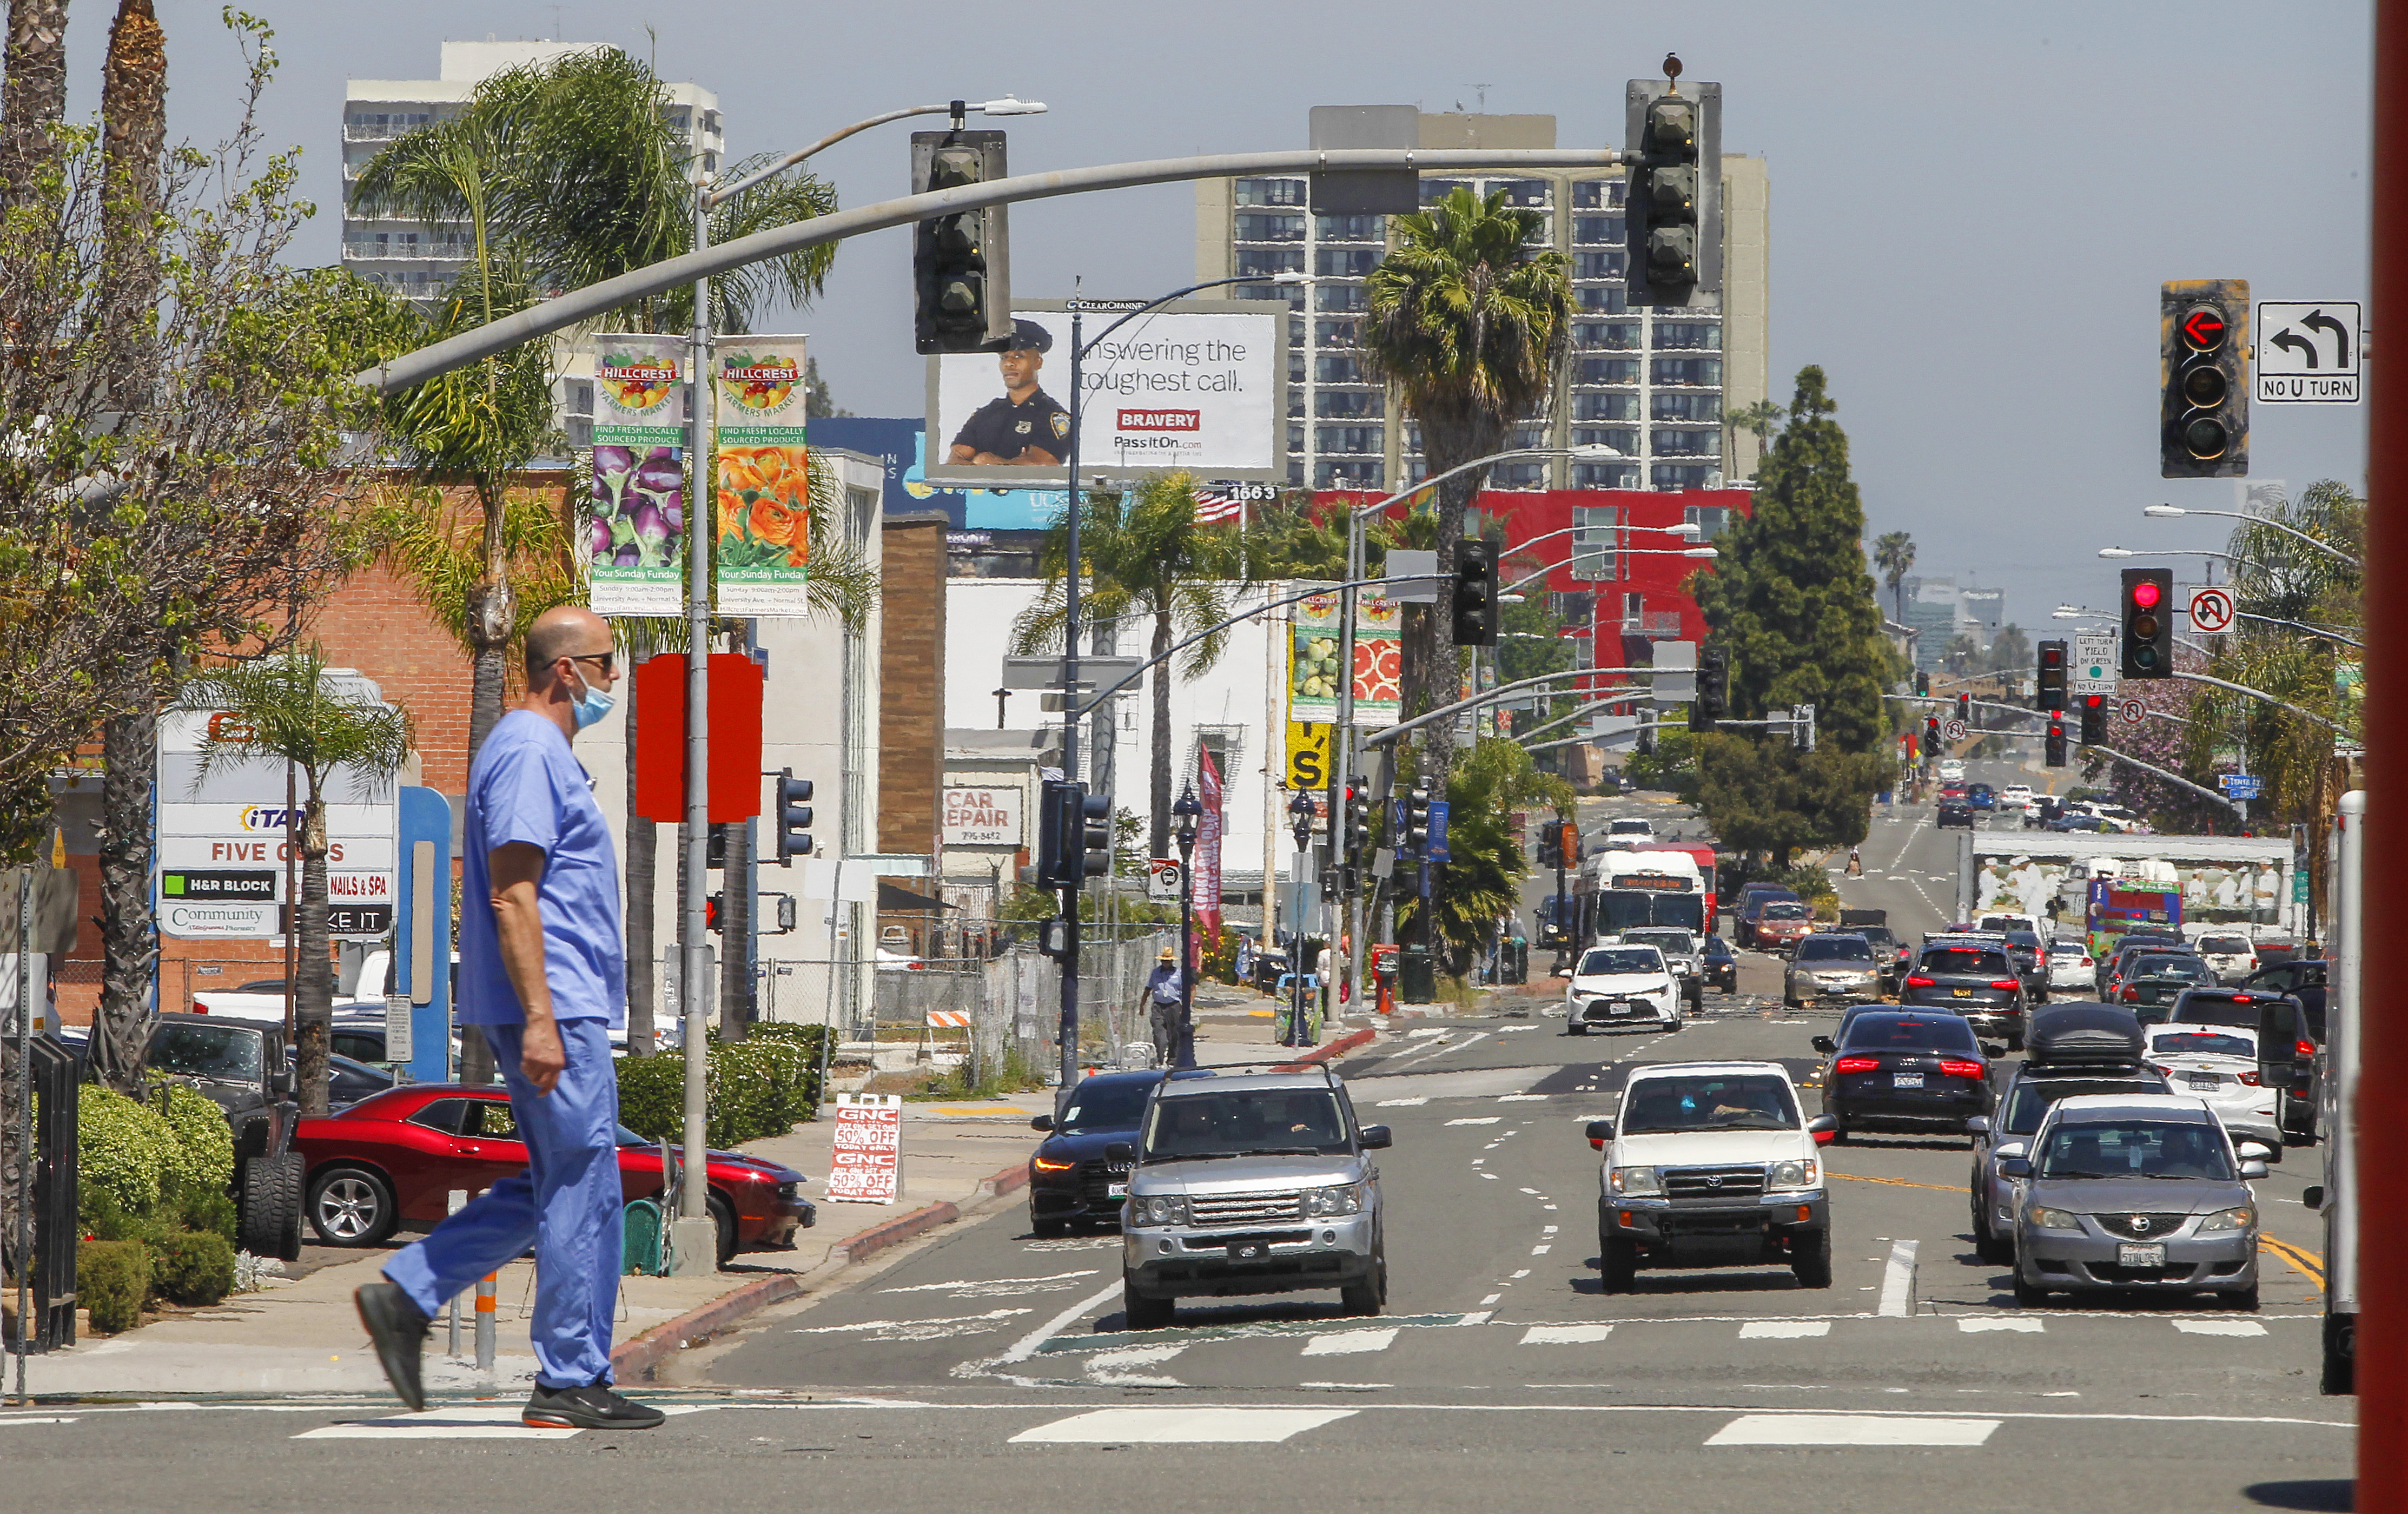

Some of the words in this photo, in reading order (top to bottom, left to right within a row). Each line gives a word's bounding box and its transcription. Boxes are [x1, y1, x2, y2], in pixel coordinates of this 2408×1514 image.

[1071, 338, 1201, 366] nswering
[1206, 339, 1247, 361] the
[604, 368, 673, 379] HILLCREST
[726, 368, 794, 379] HILLCREST
[1080, 368, 1191, 395] toughest
[1198, 369, 1243, 392] call.
[2264, 381, 2285, 396] NO
[2291, 379, 2304, 396] U
[2310, 381, 2352, 396] TURN
[599, 390, 637, 416] FARMERS
[640, 393, 674, 416] MARKET
[723, 391, 760, 417] FARMERS
[764, 391, 797, 417] MARKET
[1121, 413, 1196, 427] BRAVERY
[597, 434, 636, 442] SOURCED
[1230, 487, 1276, 500] 1663
[593, 569, 613, 578] Your
[615, 570, 646, 579] Sunday
[647, 570, 680, 580] Funday
[720, 569, 739, 578] Your
[741, 570, 772, 580] Sunday
[774, 570, 805, 580] Funday
[2085, 646, 2108, 656] YIELD
[2088, 682, 2096, 691] U
[947, 791, 994, 809] CAR
[211, 843, 267, 861] FIVE
[190, 879, 221, 891] H&R
[223, 880, 271, 892] BLOCK
[330, 875, 358, 896] NAILS
[360, 879, 366, 896] &
[368, 875, 387, 896] SPA
[172, 907, 264, 927] Community
[360, 912, 380, 929] IT
[838, 1109, 896, 1121] GNC
[837, 1129, 864, 1143] 50%
[870, 1130, 896, 1143] OFF
[836, 1143, 866, 1151] TODAY
[836, 1153, 895, 1166] GNC
[833, 1174, 862, 1188] 50%
[866, 1175, 893, 1188] OFF
[832, 1188, 864, 1196] TODAY
